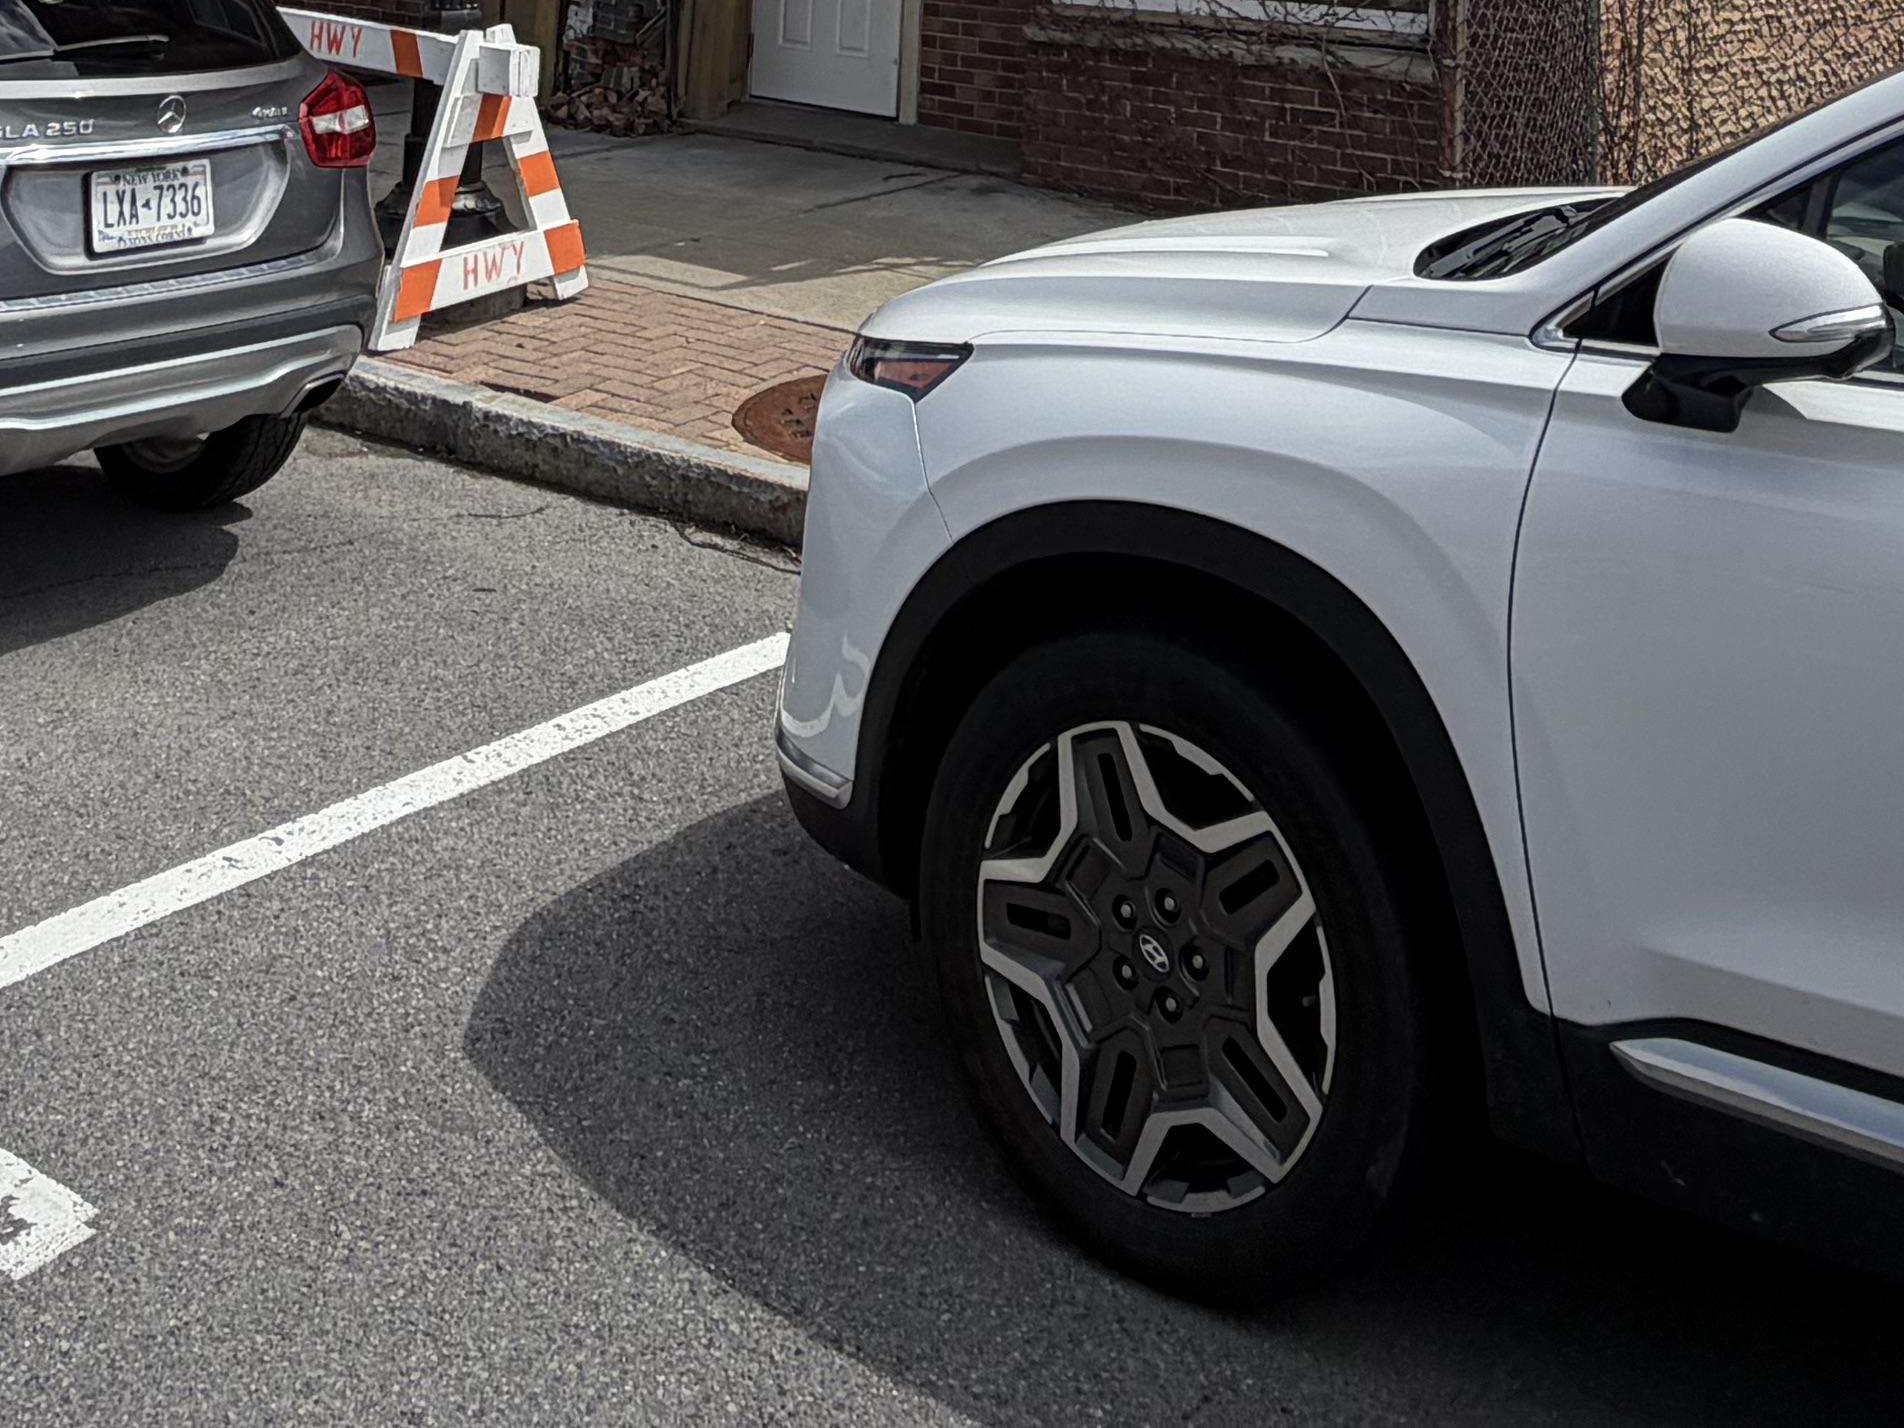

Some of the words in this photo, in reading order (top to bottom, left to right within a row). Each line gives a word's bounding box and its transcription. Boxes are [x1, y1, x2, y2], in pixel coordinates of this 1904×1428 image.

[309, 20, 363, 58] HWY
[45, 118, 96, 137] 250
[123, 174, 148, 186] NEW
[151, 169, 180, 182] YORK
[462, 240, 526, 291] HWY
